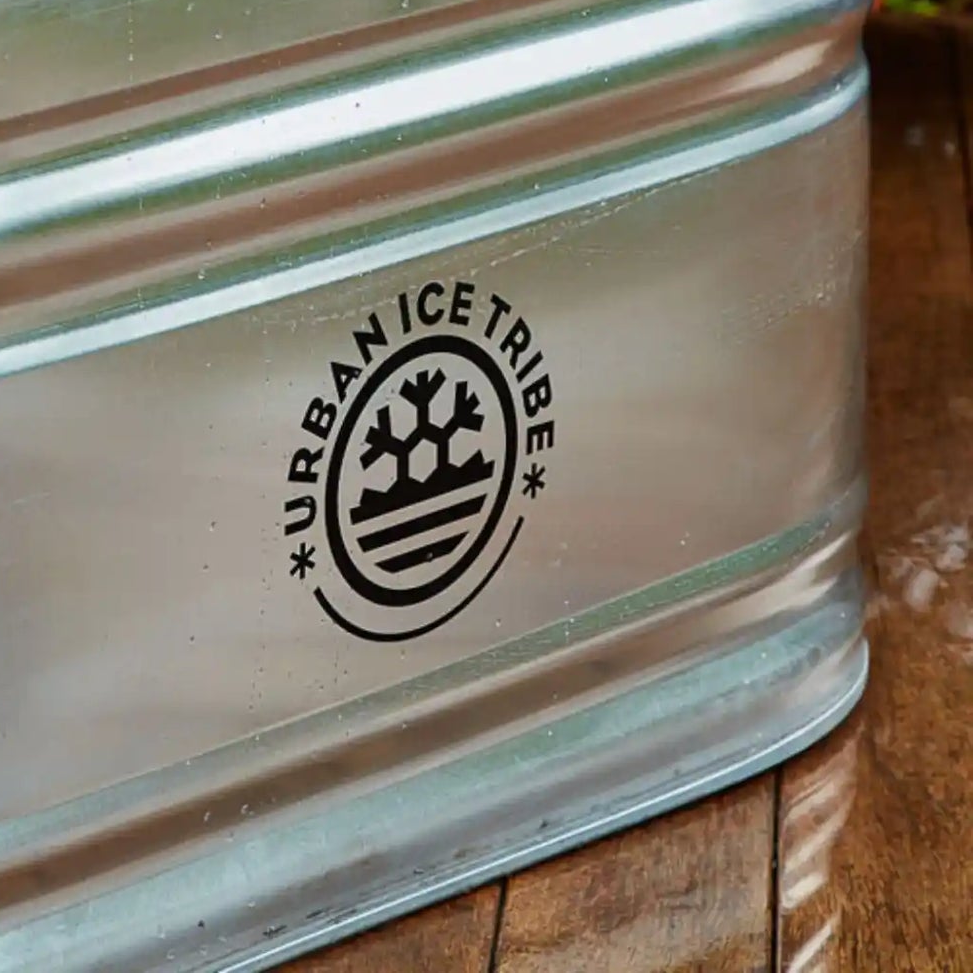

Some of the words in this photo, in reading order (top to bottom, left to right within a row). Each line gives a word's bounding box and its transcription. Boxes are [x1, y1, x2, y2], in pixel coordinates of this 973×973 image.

[284, 312, 388, 536] URBAN
[398, 281, 475, 335] ICE
[483, 293, 555, 456] TRIBE
